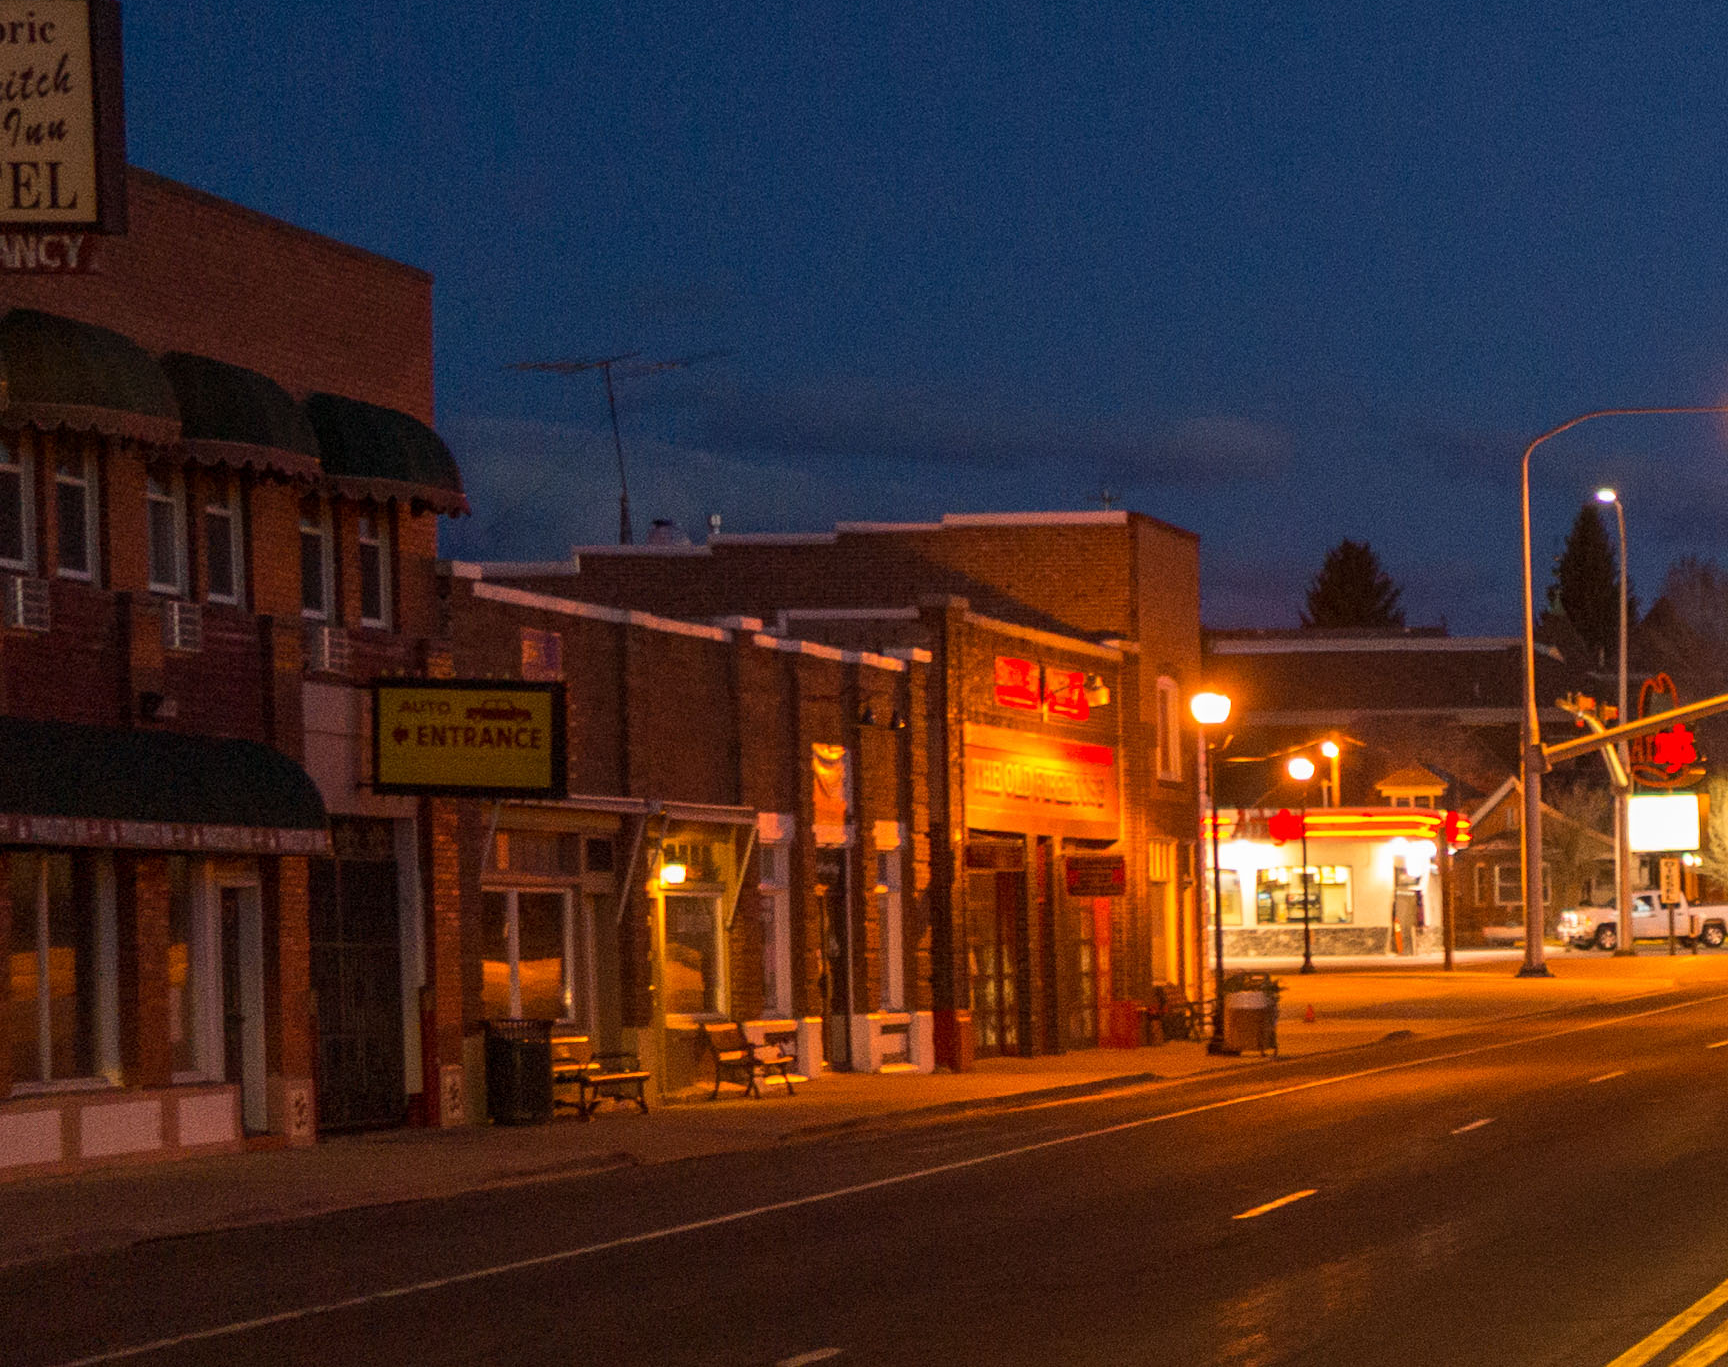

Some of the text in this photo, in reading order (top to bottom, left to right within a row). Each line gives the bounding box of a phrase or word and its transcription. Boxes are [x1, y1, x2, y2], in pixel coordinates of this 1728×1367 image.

[0, 52, 74, 103] itch
[3, 107, 68, 147] Inn
[0, 161, 77, 210] EL
[398, 699, 450, 715] AUTO
[416, 724, 542, 749] ENTRANCE
